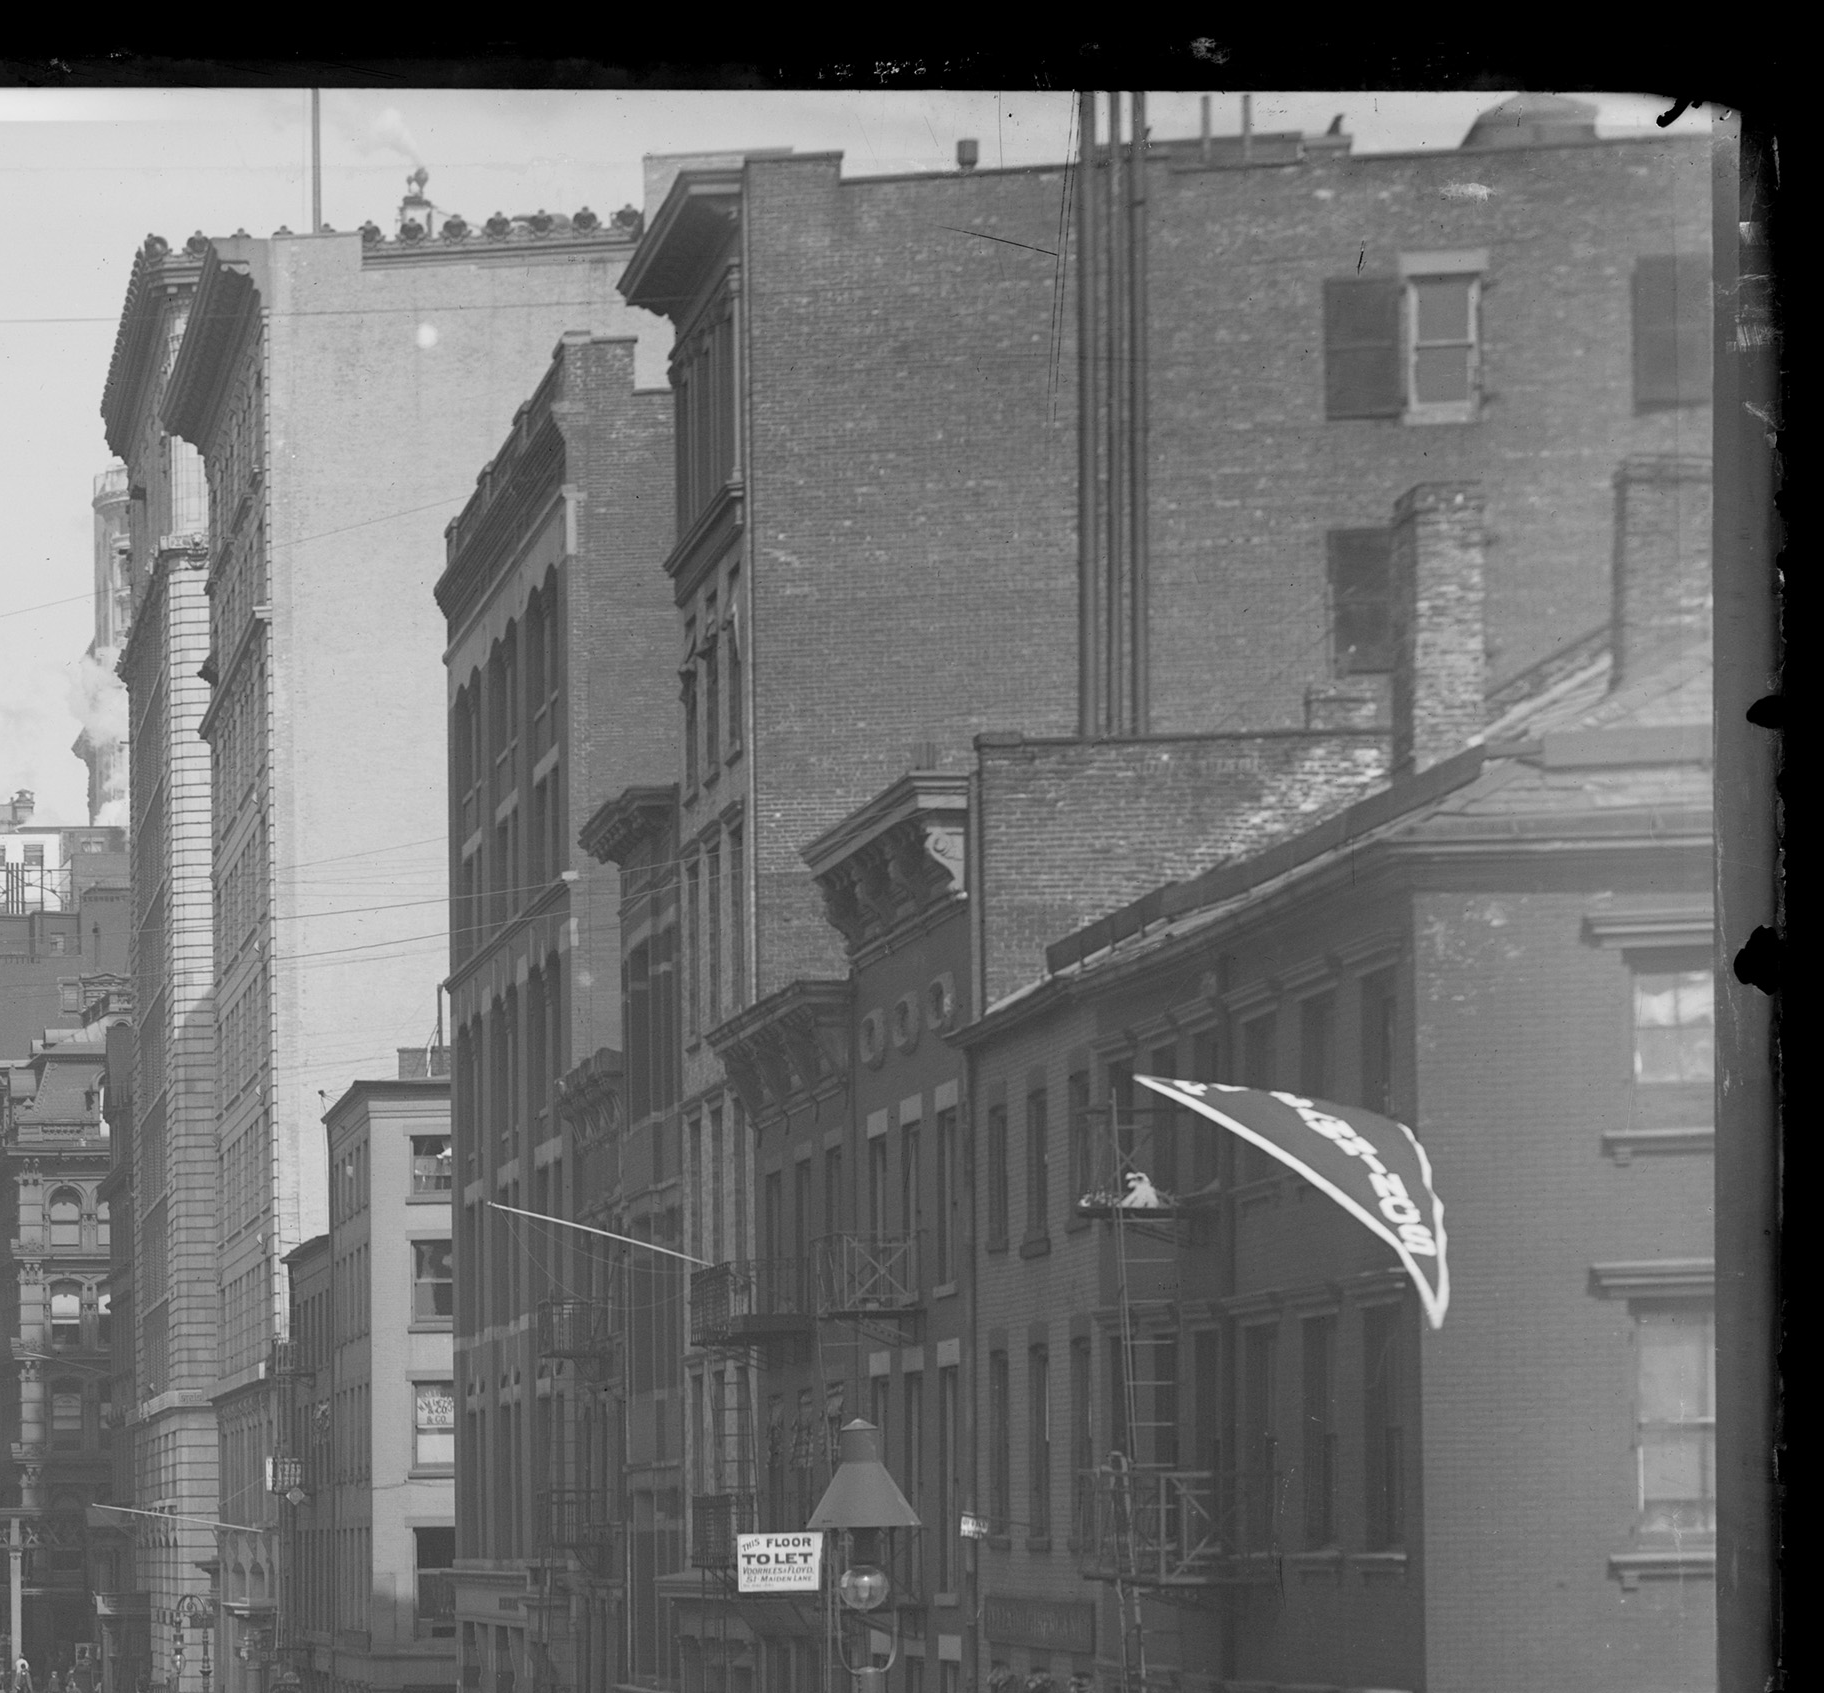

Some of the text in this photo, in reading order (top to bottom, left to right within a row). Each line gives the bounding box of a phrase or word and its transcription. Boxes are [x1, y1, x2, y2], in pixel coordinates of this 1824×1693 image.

[742, 1537, 812, 1552] THIS FLOOR
[742, 1552, 813, 1565] TO LET
